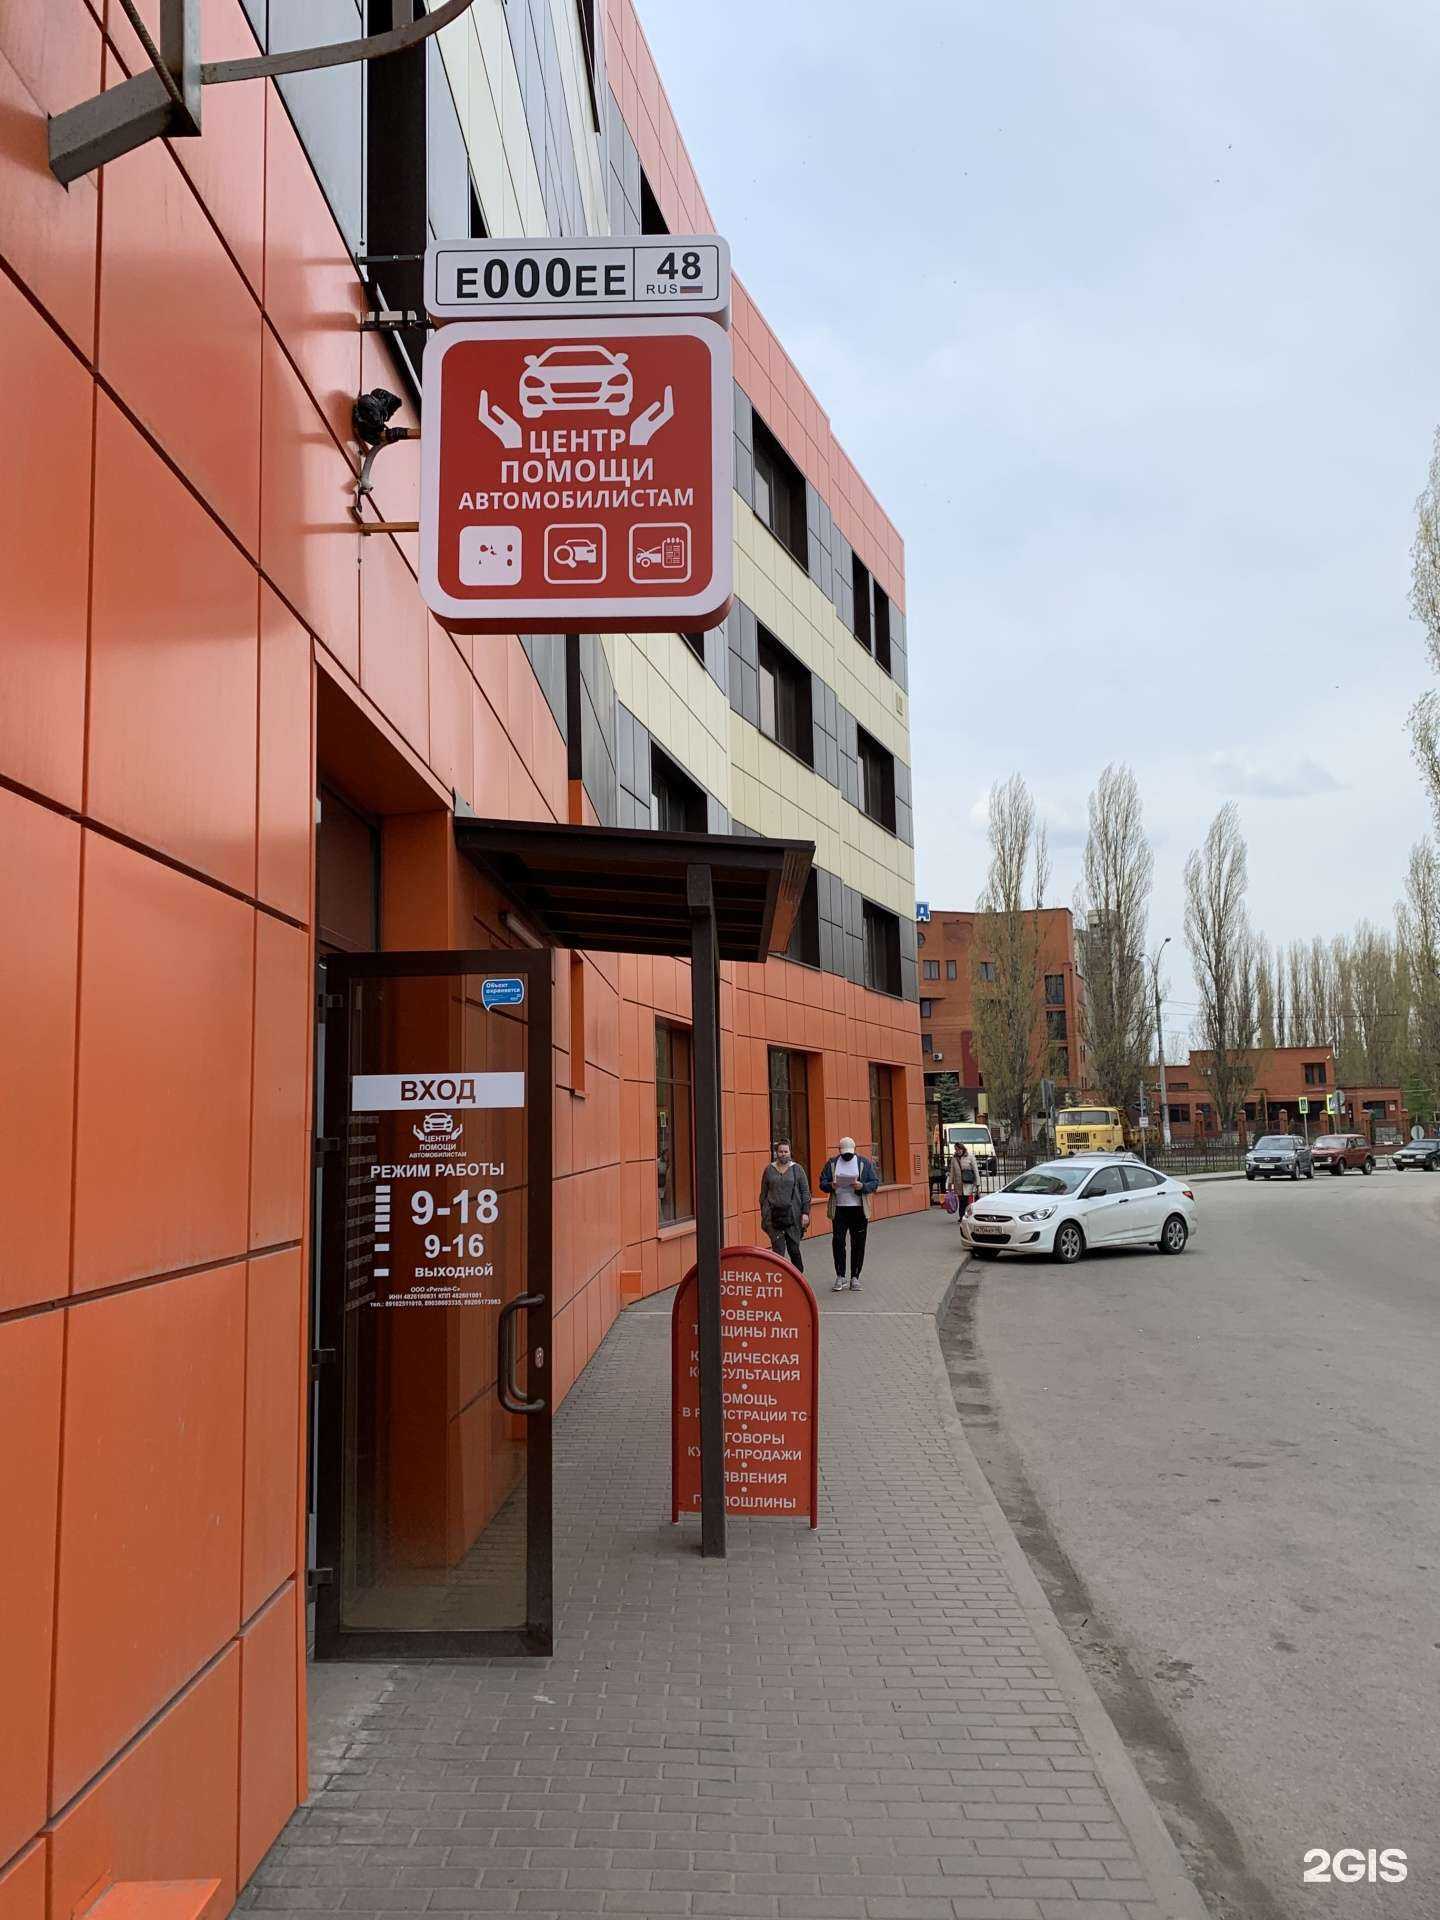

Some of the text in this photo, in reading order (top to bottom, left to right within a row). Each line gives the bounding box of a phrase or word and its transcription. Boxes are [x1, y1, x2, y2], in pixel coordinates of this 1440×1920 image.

[456, 252, 702, 299] Е000ЕЕ 48
[646, 284, 678, 295] RUS
[529, 428, 627, 459] ЦЕНТР
[500, 458, 655, 487] ПОМОЩИ
[458, 487, 694, 511] АВТОМОБИЛИСТАМ
[400, 1079, 476, 1104] ВХОД
[424, 1135, 451, 1143] ЦЕНТР
[419, 1143, 457, 1151] ПОМОЩИ
[408, 1151, 467, 1159] АВТОМОБИЛИСТАМ
[370, 1162, 504, 1179] РЕЖИМ РАБОТЫ
[411, 1189, 499, 1225] 9-18
[424, 1233, 485, 1259] 9-16
[720, 1270, 783, 1284] ЦЕНКА ТС
[720, 1285, 783, 1299] ОСЛЕ ДТП
[720, 1309, 782, 1322] РОВЕРКА
[691, 1324, 799, 1339] ТЩИНЫ ЛКП
[690, 1350, 800, 1365] ЮДИЧЕСКАЯ
[689, 1366, 801, 1383] КСУЛЬТАЦИЯ
[722, 1392, 778, 1407] ОМОЩЬ
[682, 1407, 691, 1417] В
[791, 1411, 808, 1422] ТС
[724, 1432, 785, 1445] ГОВОРЫ
[687, 1446, 802, 1462] КУИ-ПРОДАЖИ
[723, 1471, 787, 1484] ЯВЛЕНИЯ
